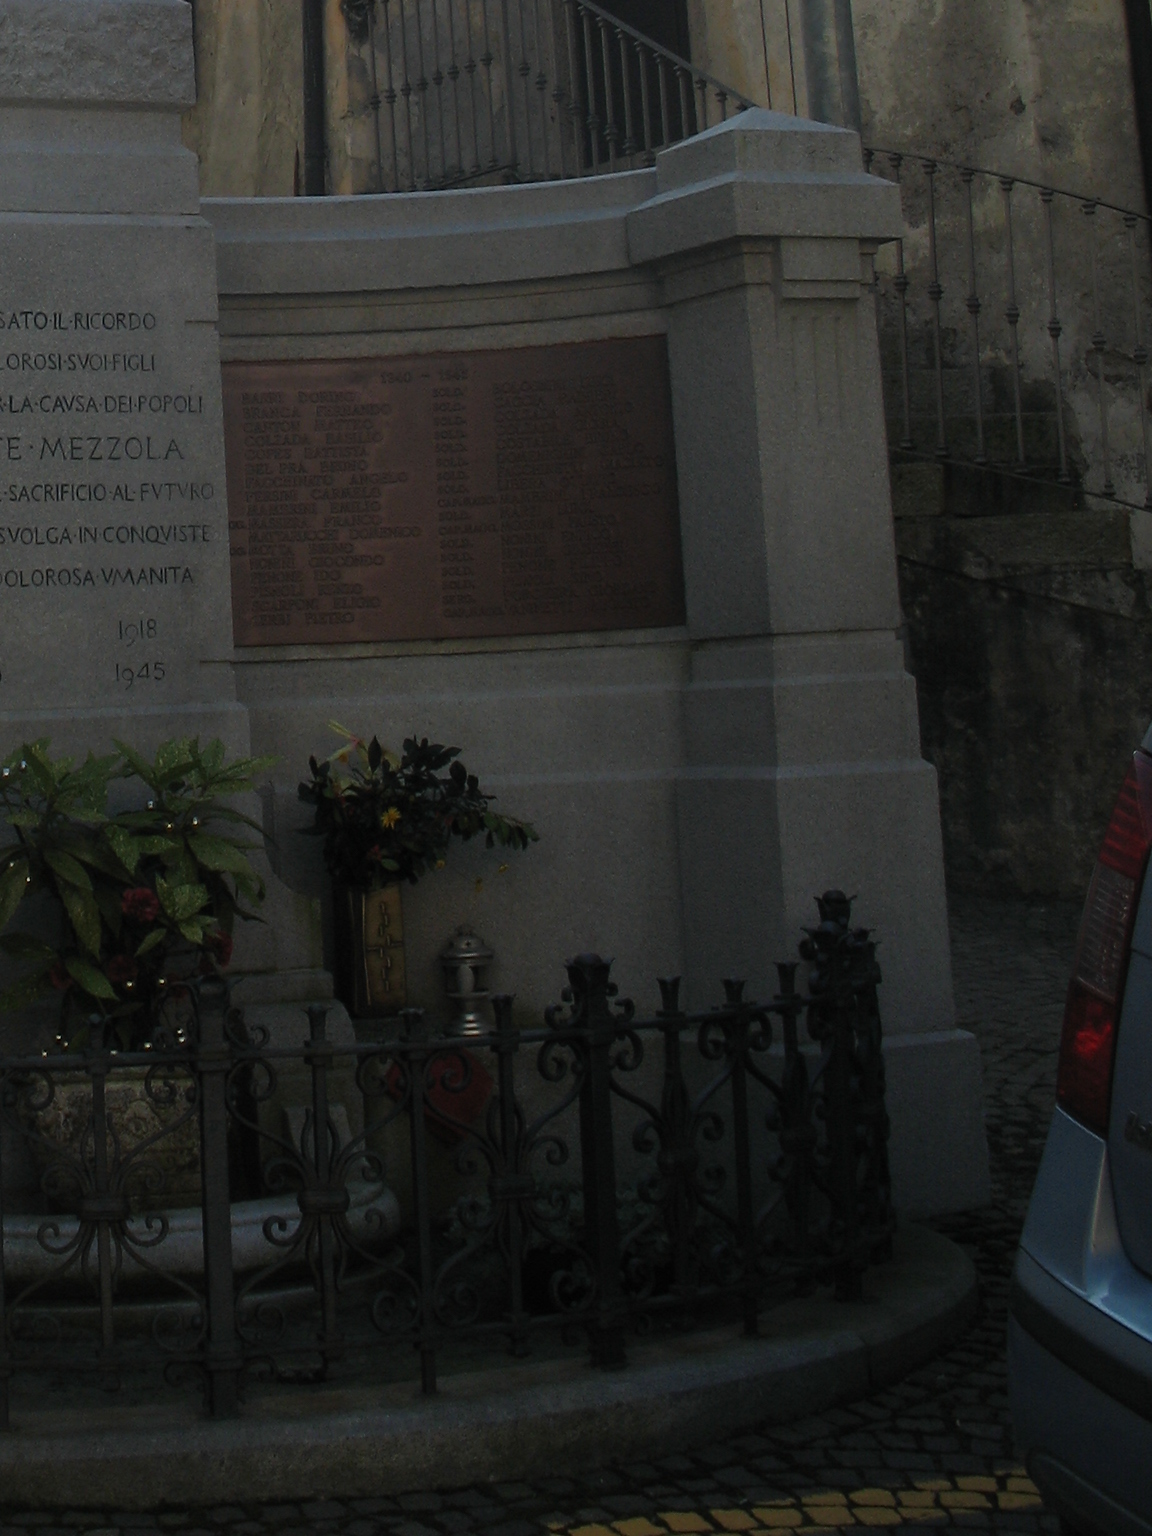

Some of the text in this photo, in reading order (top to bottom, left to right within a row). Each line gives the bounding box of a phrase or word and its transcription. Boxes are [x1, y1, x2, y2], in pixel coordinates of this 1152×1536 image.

[53, 313, 69, 330] IL
[74, 313, 156, 330] RICORDO
[112, 354, 155, 371] FIGLI
[9, 395, 33, 413] LA
[40, 395, 99, 413] CAVSA
[105, 395, 131, 413] DEI
[138, 395, 202, 413] POPOLI
[40, 437, 184, 461] MEZZOLA
[9, 483, 107, 502] SACRIFICIO
[113, 483, 135, 501] AL
[79, 527, 98, 544] IN
[103, 525, 210, 546] CONQVISTE
[101, 567, 194, 585] VMANITA
[119, 620, 157, 647] 1918
[116, 662, 166, 690] 1945
